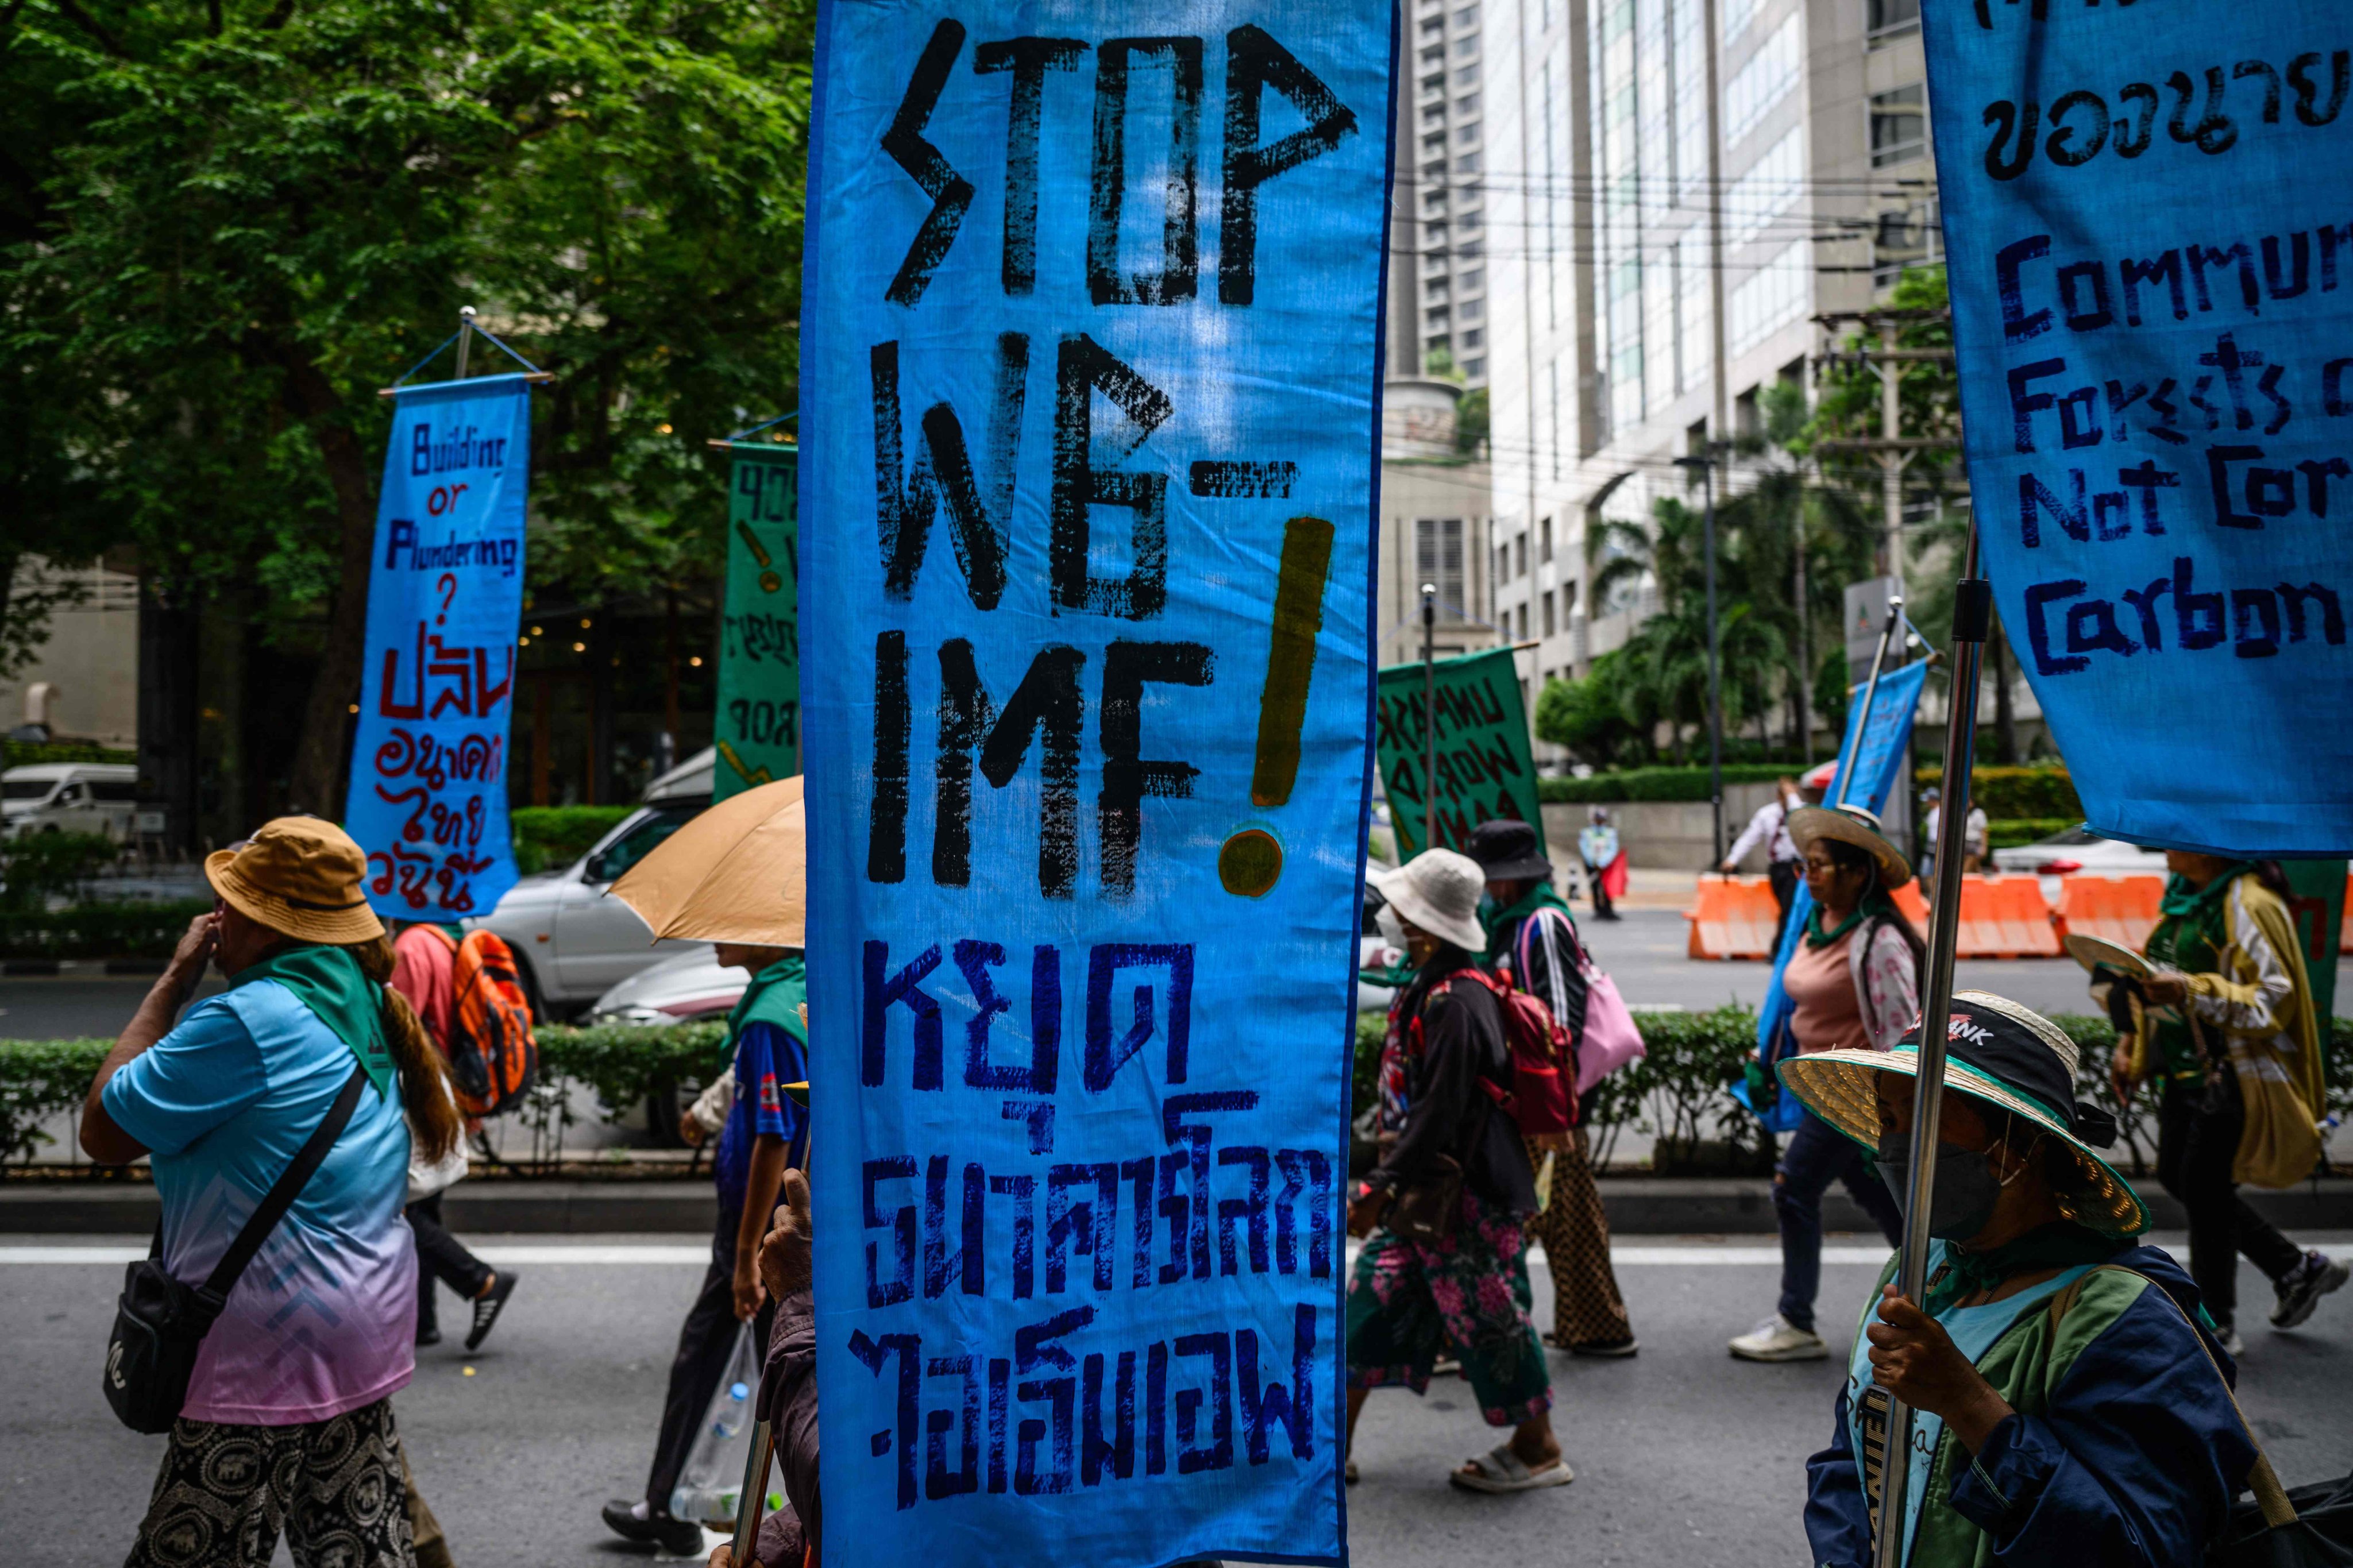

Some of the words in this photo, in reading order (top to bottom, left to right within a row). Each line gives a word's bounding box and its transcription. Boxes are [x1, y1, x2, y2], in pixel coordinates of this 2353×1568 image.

[881, 18, 1358, 308] STOP
[411, 423, 507, 478] Building
[427, 484, 468, 516] or
[2019, 460, 2181, 548] Not
[385, 520, 516, 576] Plundering
[437, 573, 457, 626] ?
[2024, 557, 2347, 676] Carbon
[380, 621, 513, 719] ปล้น
[862, 939, 1197, 1154] หยุด
[863, 1090, 1331, 1310] ธนาคารโลก
